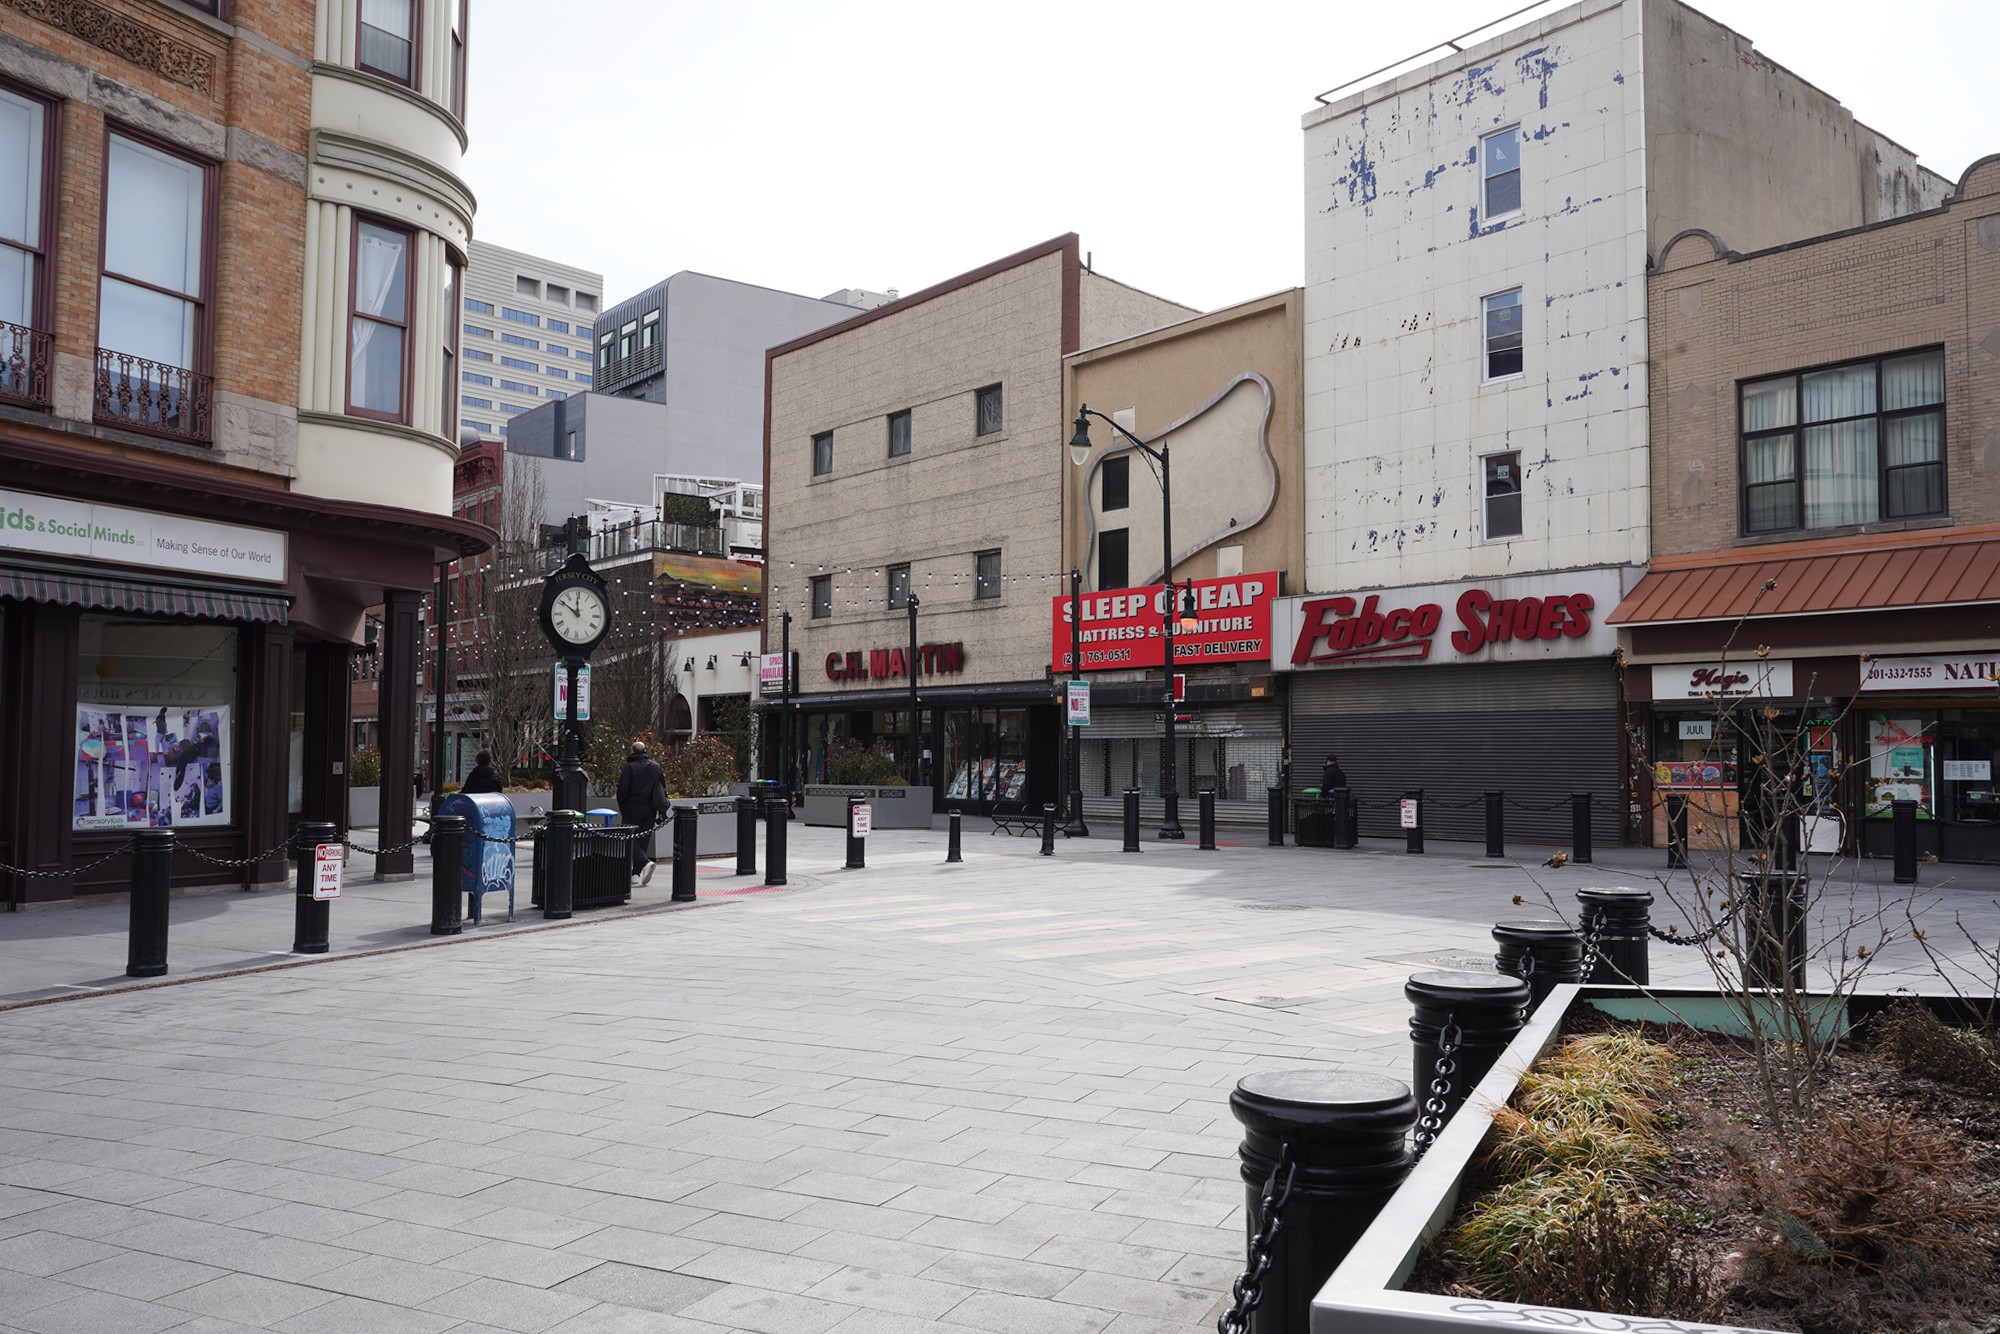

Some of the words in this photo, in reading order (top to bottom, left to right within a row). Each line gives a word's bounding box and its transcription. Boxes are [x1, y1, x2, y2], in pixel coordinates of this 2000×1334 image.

[37, 521, 46, 533] &
[48, 519, 91, 539] Social
[93, 526, 136, 545] Minds
[156, 537, 189, 555] Making
[191, 543, 218, 558] Sense
[220, 547, 230, 558] of
[231, 548, 246, 560] Our
[248, 550, 272, 564] World
[554, 571, 581, 584] JERSEY
[582, 573, 599, 586] CITY
[1062, 594, 1147, 624] SLEEP
[1154, 581, 1264, 614] CHEAP
[1148, 626, 1160, 638] &
[1163, 616, 1253, 637] UNITURE
[1291, 594, 1443, 664] Fabco
[1450, 588, 1595, 654] SHOES
[1063, 651, 1086, 667] (2)
[1087, 649, 1131, 663] 761-0511
[1173, 643, 1202, 657] FAST
[1204, 639, 1262, 655] DELIVERY
[826, 651, 868, 681] C.H.
[870, 642, 963, 678] MARTIN
[1690, 668, 1750, 690] Magic
[1686, 725, 1704, 735] JUUL
[318, 848, 326, 858] NO
[321, 874, 337, 882] TIME
